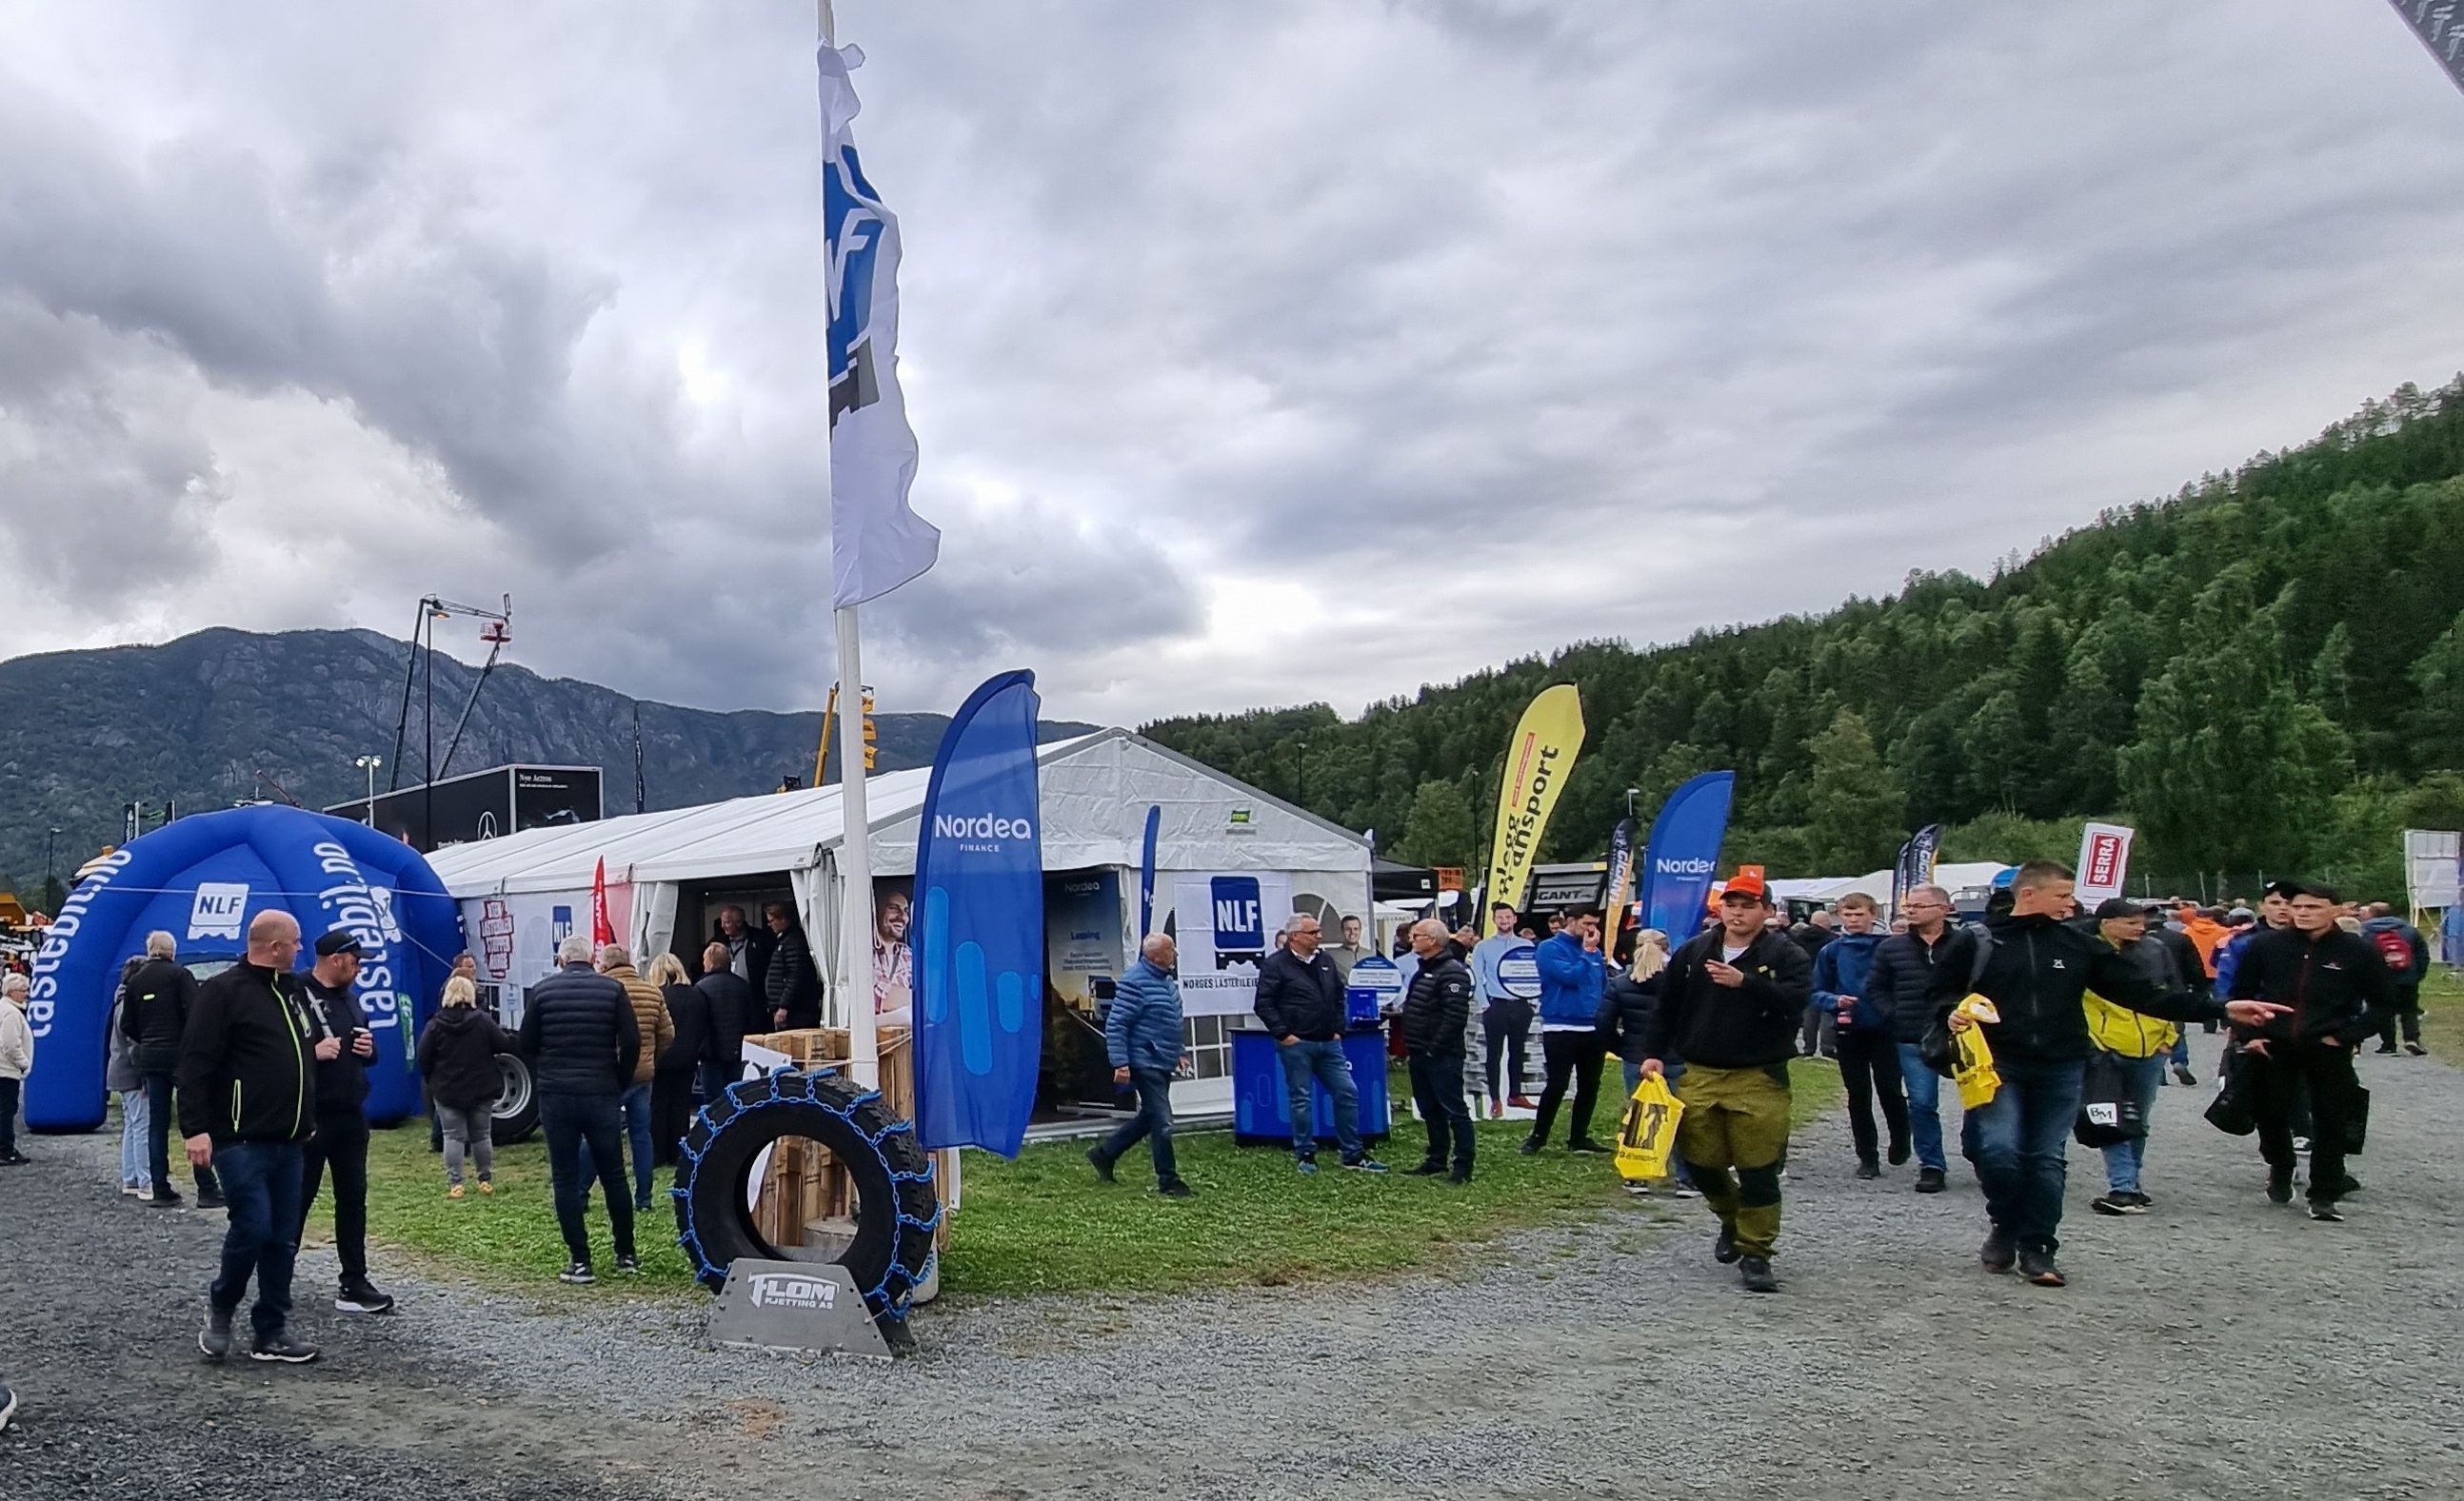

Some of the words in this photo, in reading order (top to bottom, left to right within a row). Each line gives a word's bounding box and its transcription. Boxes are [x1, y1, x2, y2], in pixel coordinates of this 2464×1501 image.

[935, 812, 1032, 839] Nordea
[960, 843, 1001, 853] FINANCE
[2093, 838, 2116, 884] SERRA
[198, 896, 242, 915] NLF
[1217, 899, 1259, 933] NLF
[1182, 978, 1214, 990] NORGES
